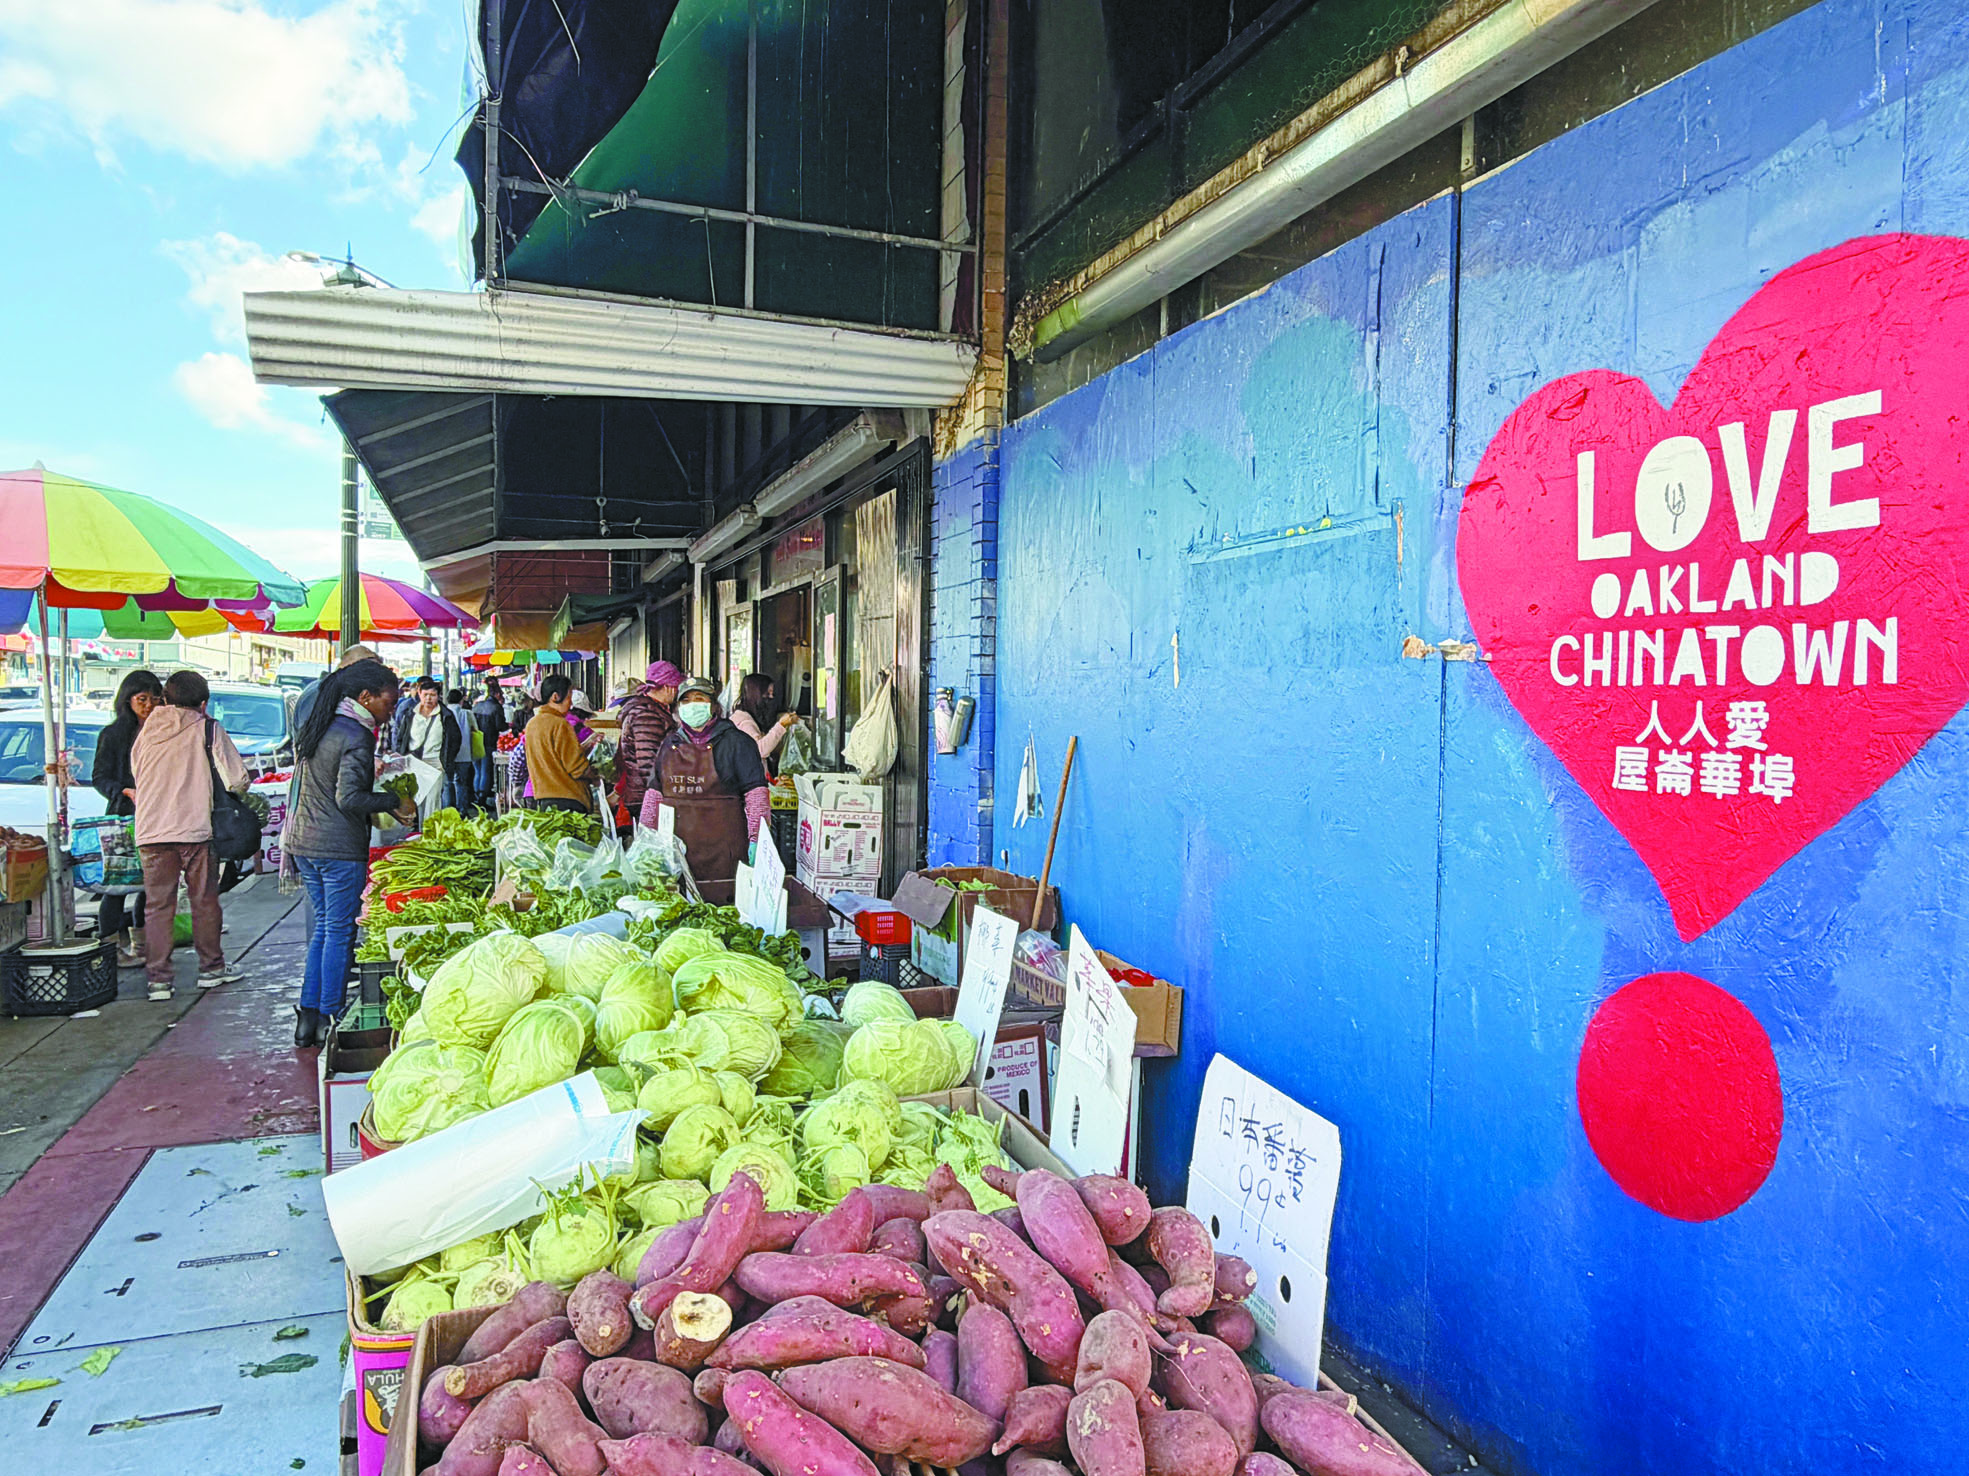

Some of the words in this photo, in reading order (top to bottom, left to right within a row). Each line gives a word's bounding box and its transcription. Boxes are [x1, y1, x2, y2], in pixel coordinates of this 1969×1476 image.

[1577, 390, 1882, 561] LOVE
[1590, 551, 1840, 619] OAKLAND
[1550, 617, 1898, 687] CHINATOWN
[1635, 700, 1770, 751] 人人愛
[1611, 746, 1796, 804] 屋崙華埠
[1015, 965, 1043, 996] MARKET
[997, 1062, 1028, 1073] PRODUCE
[1029, 1060, 1038, 1068] OF
[1006, 1068, 1031, 1078] MEXICO
